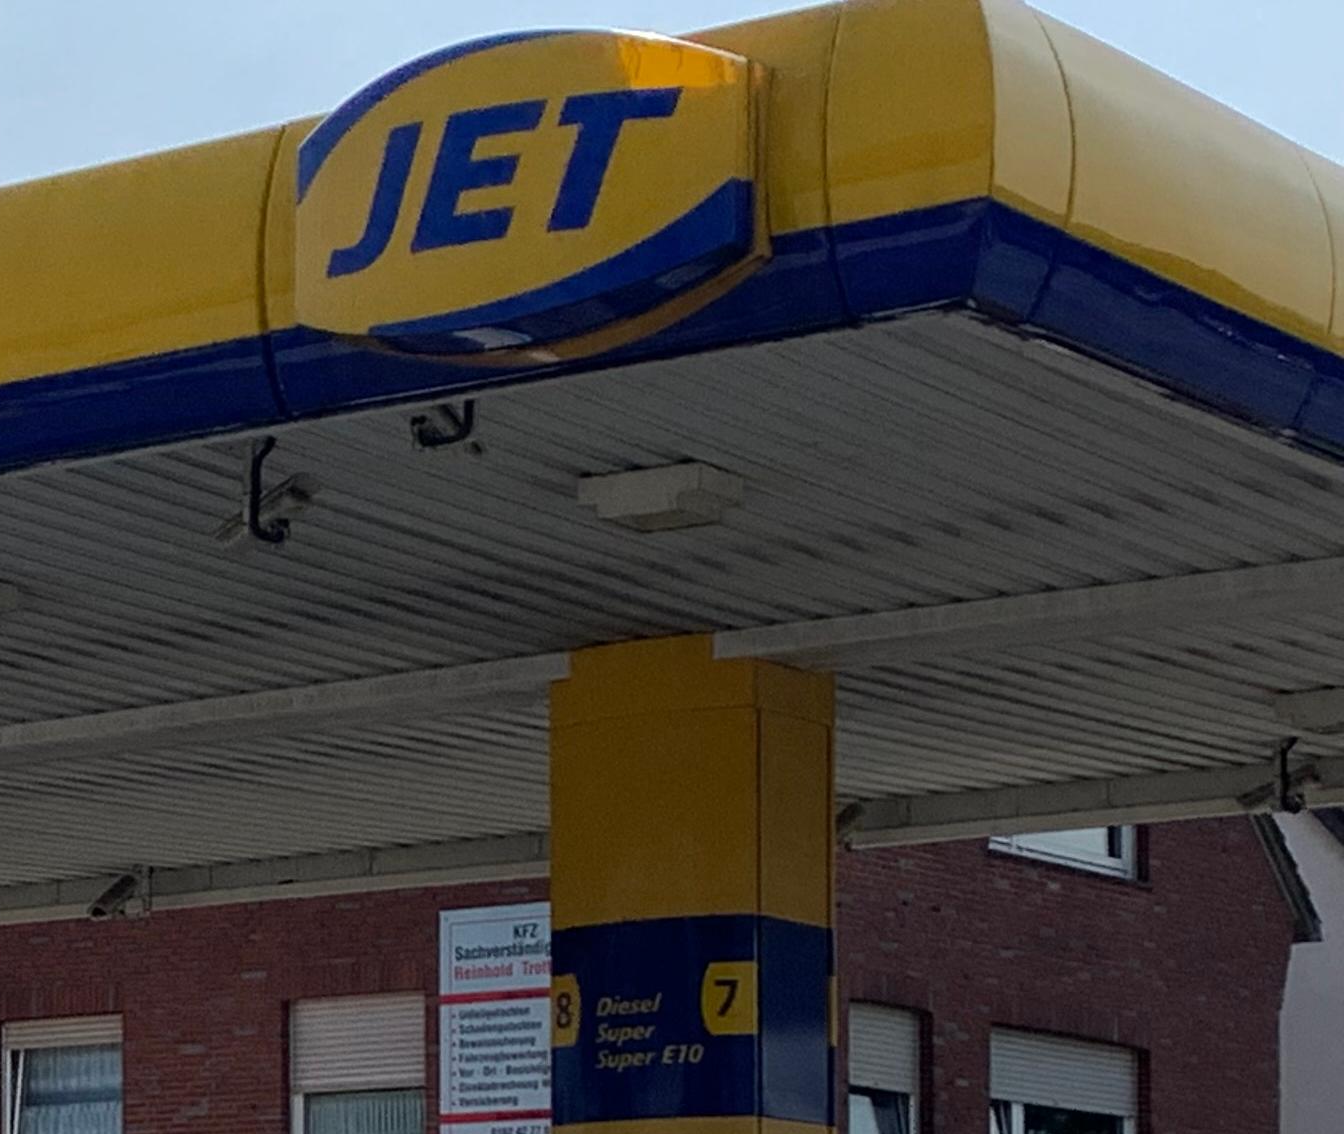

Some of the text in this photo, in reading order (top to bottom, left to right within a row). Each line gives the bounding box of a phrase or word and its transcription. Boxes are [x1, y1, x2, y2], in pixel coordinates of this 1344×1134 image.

[325, 86, 684, 280] JET
[512, 922, 539, 940] KFZ
[555, 991, 573, 1029] 8
[595, 992, 662, 1017] Diesel
[713, 979, 739, 1018] 7
[594, 1023, 657, 1047] Super
[594, 1044, 705, 1073] Super E10
